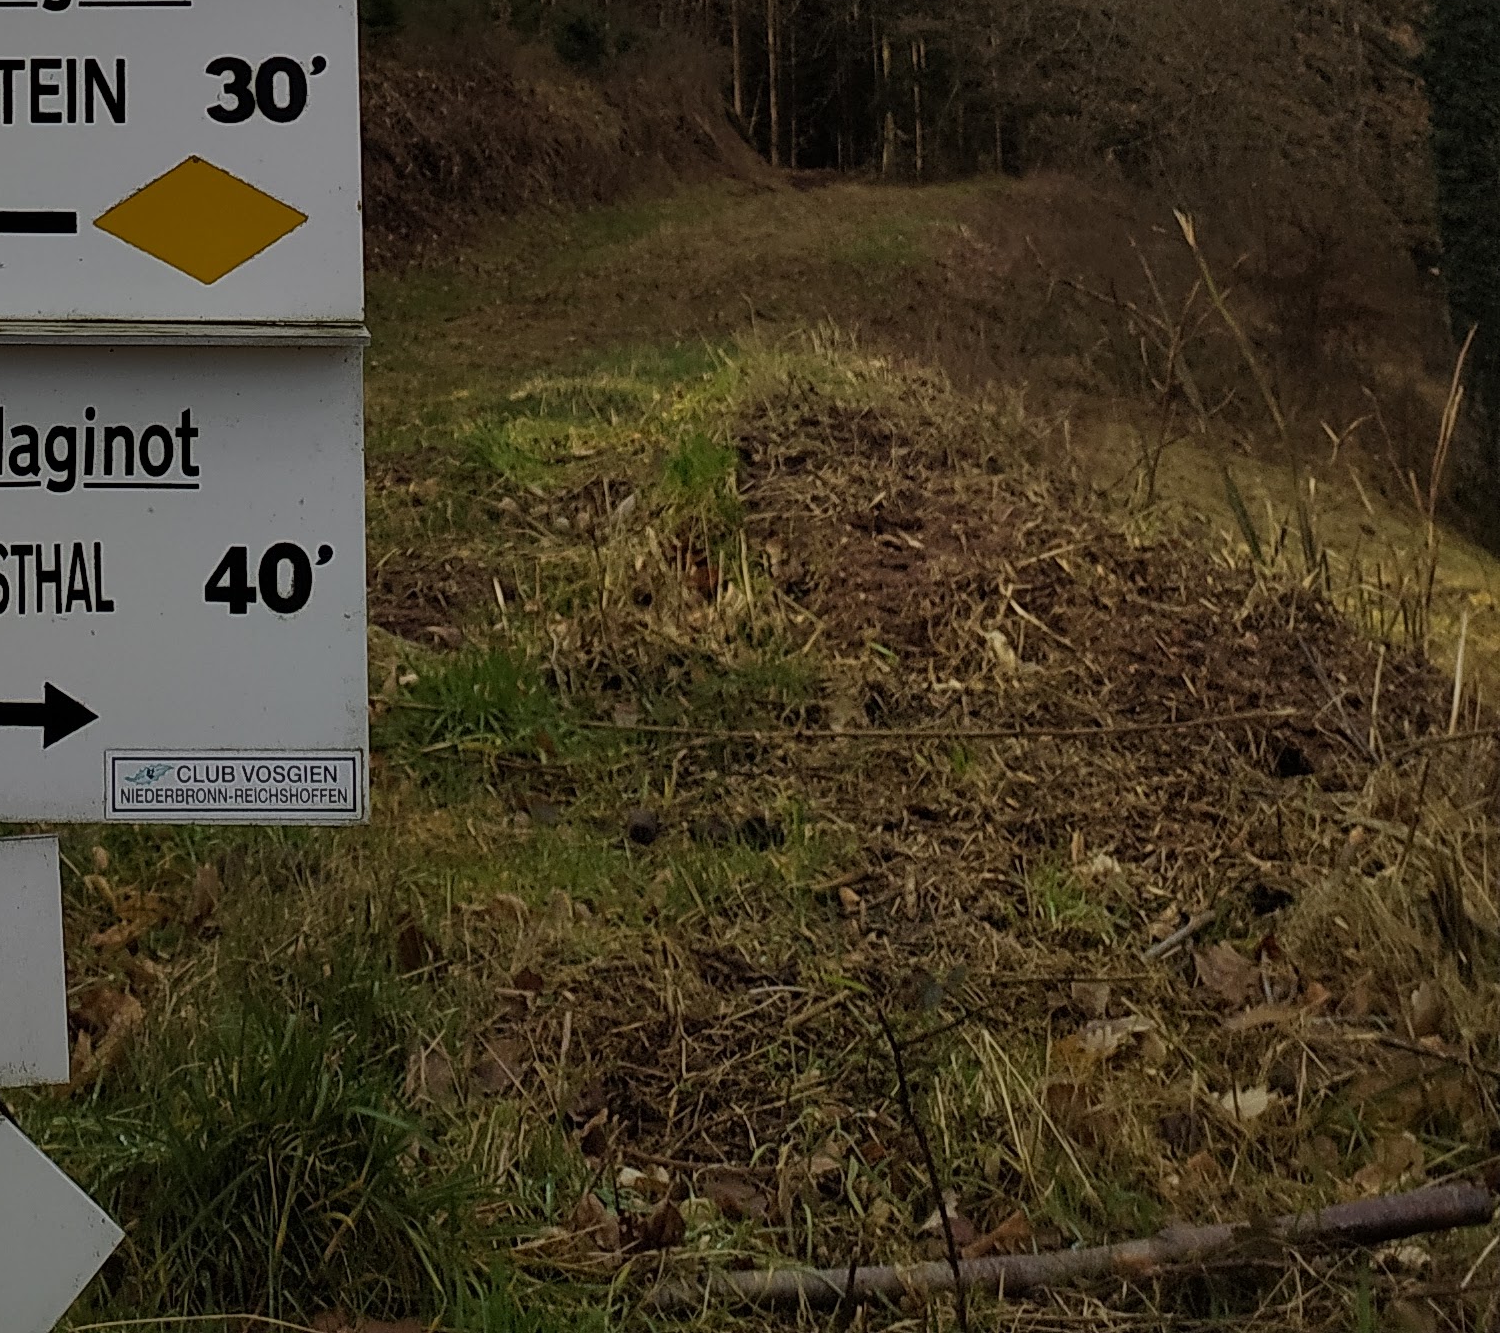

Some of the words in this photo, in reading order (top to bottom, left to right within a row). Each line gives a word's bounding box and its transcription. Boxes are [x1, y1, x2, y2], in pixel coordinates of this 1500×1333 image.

[175, 764, 235, 783] CLUB
[238, 764, 339, 783] VOSGIEN
[120, 787, 348, 805] NIEDERBRONN-REICHSHOFFEN
